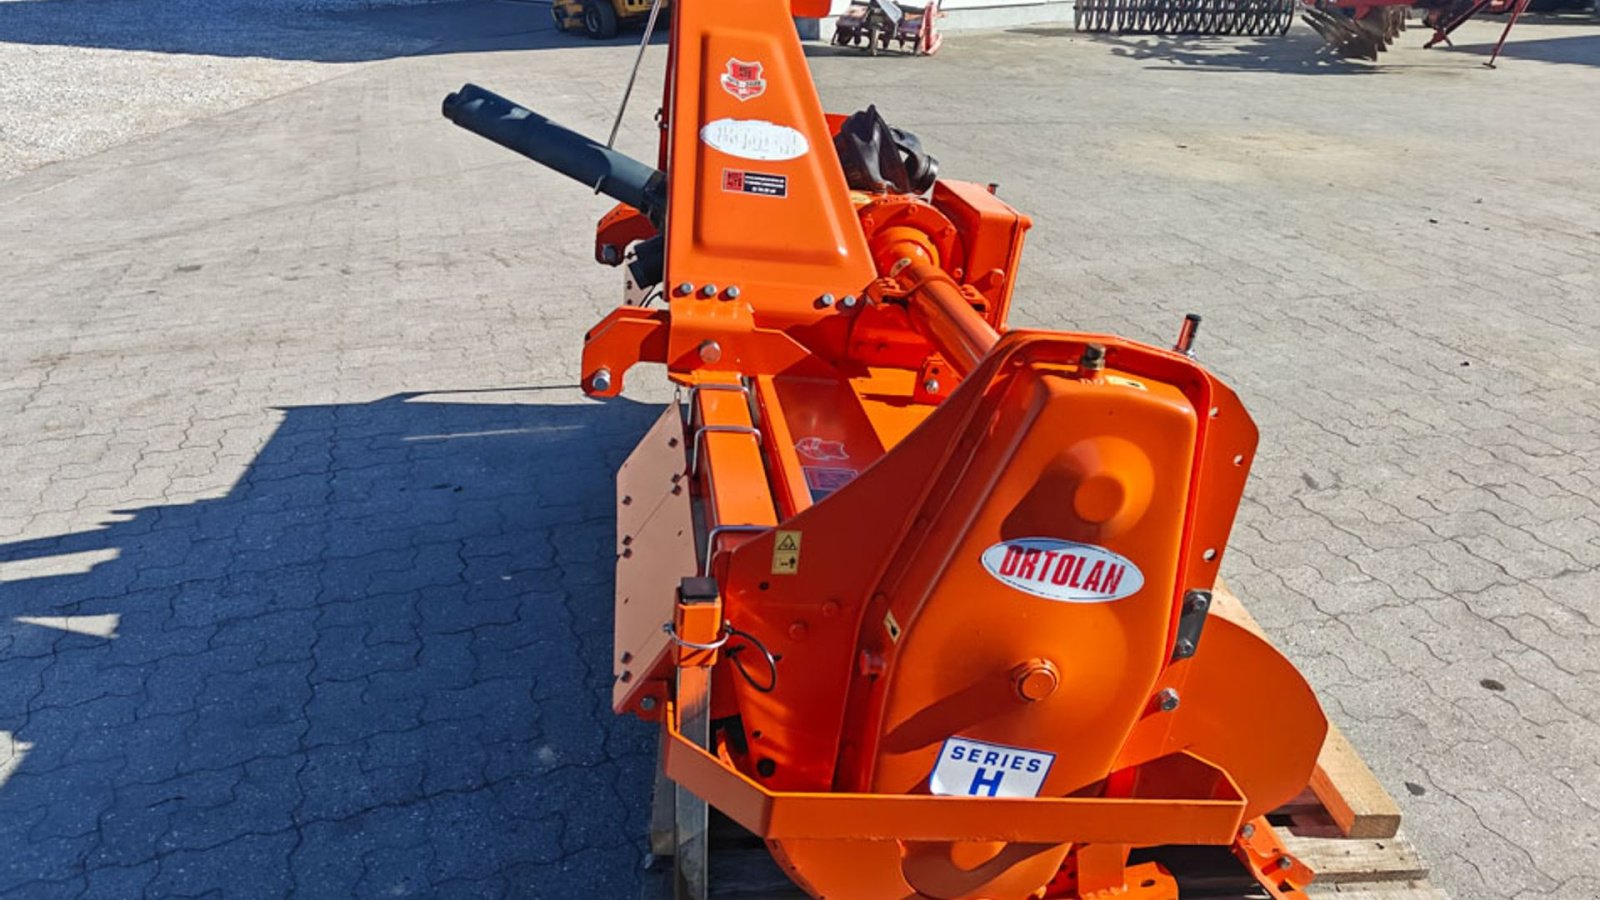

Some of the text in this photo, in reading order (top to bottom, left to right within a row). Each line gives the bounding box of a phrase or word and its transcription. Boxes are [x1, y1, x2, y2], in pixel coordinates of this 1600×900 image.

[999, 545, 1125, 594] ORTOLAN
[950, 746, 1041, 772] SERIES
[968, 767, 1005, 797] H
